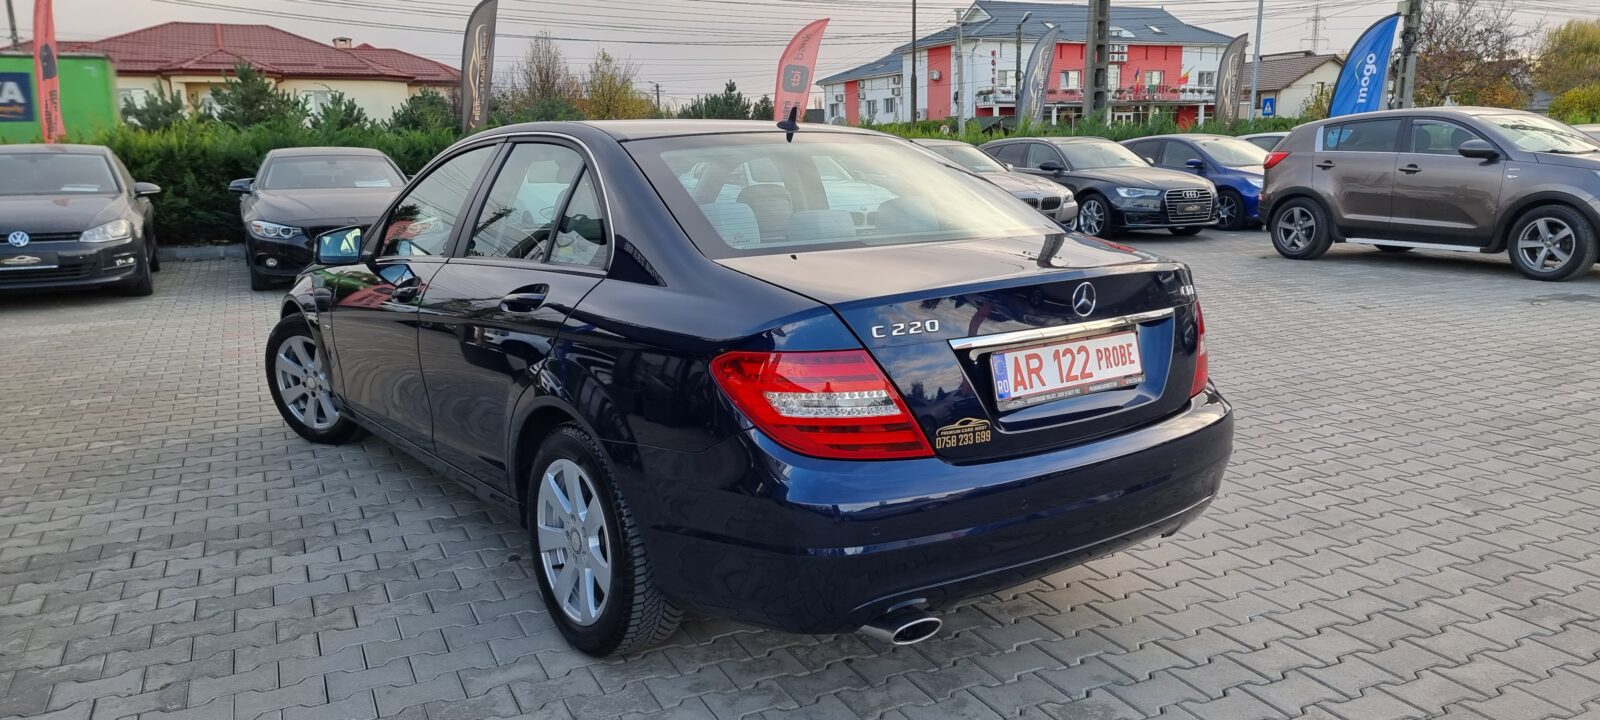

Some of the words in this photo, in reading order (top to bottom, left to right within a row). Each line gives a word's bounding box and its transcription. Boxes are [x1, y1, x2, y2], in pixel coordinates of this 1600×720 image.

[1356, 53, 1377, 104] mogo
[871, 325, 887, 339] C
[892, 319, 939, 337] 220
[1013, 352, 1046, 393] AR
[1053, 345, 1093, 384] 122
[1096, 343, 1135, 370] PROBE
[998, 380, 1009, 394] RO
[936, 436, 957, 448] 0758
[959, 433, 974, 446] 233
[975, 430, 991, 443] 699
